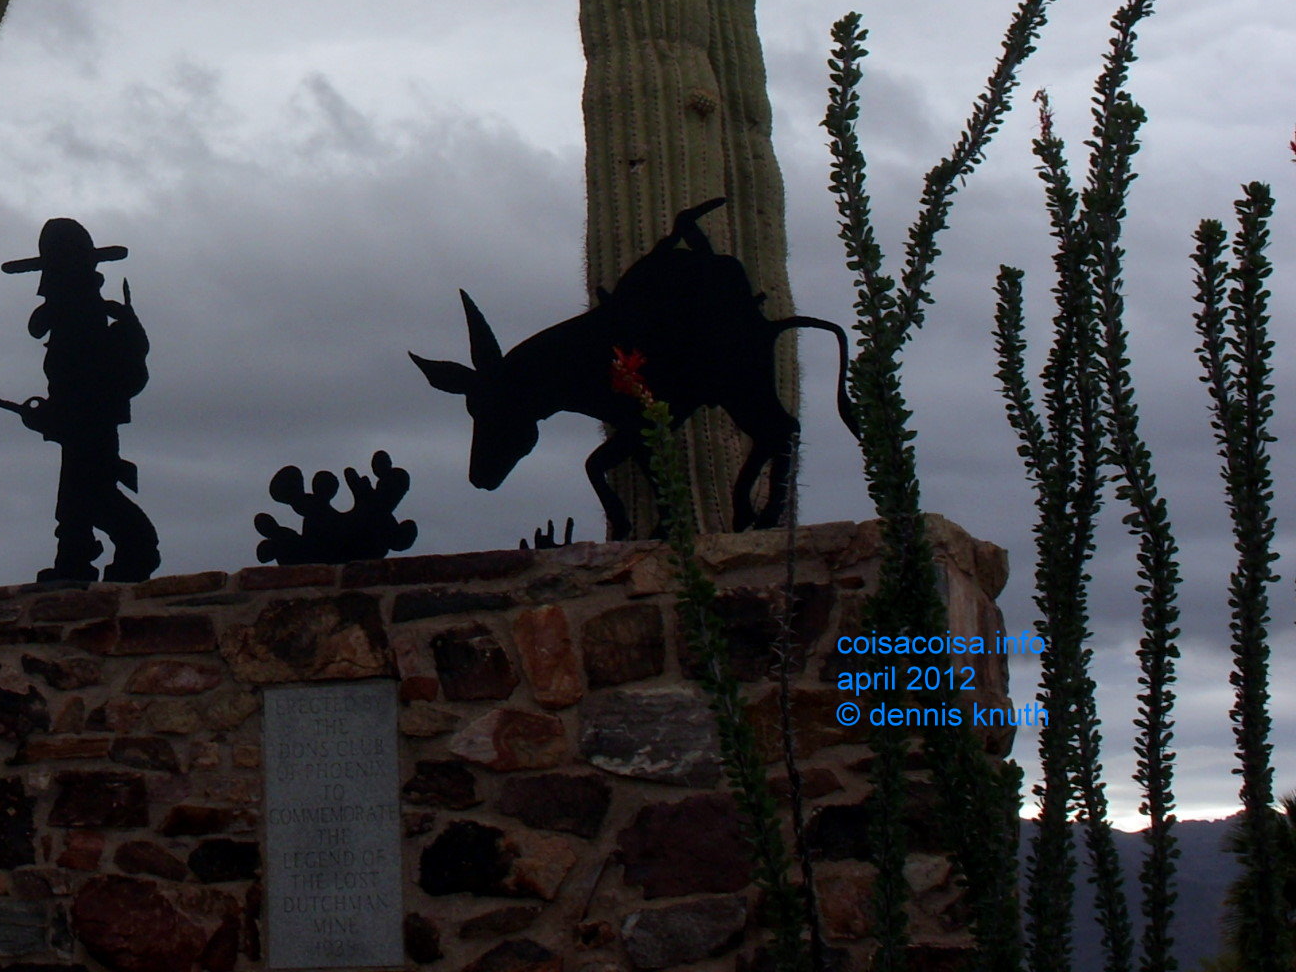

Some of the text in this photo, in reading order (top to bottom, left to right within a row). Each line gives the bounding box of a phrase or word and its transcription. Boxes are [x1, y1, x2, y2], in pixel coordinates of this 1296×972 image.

[275, 695, 384, 715] ERECTED BY
[312, 717, 349, 736] THE
[279, 737, 384, 759] DONS CLUB
[277, 759, 387, 781] OF PHOENIX
[320, 783, 345, 801] TO
[269, 803, 398, 825] COMMEMORATE
[316, 828, 350, 846] THE
[283, 847, 386, 869] LEGEND OF
[290, 871, 380, 890] THE LOST
[283, 893, 389, 913] DUTCHMAN
[312, 916, 359, 934] MINE
